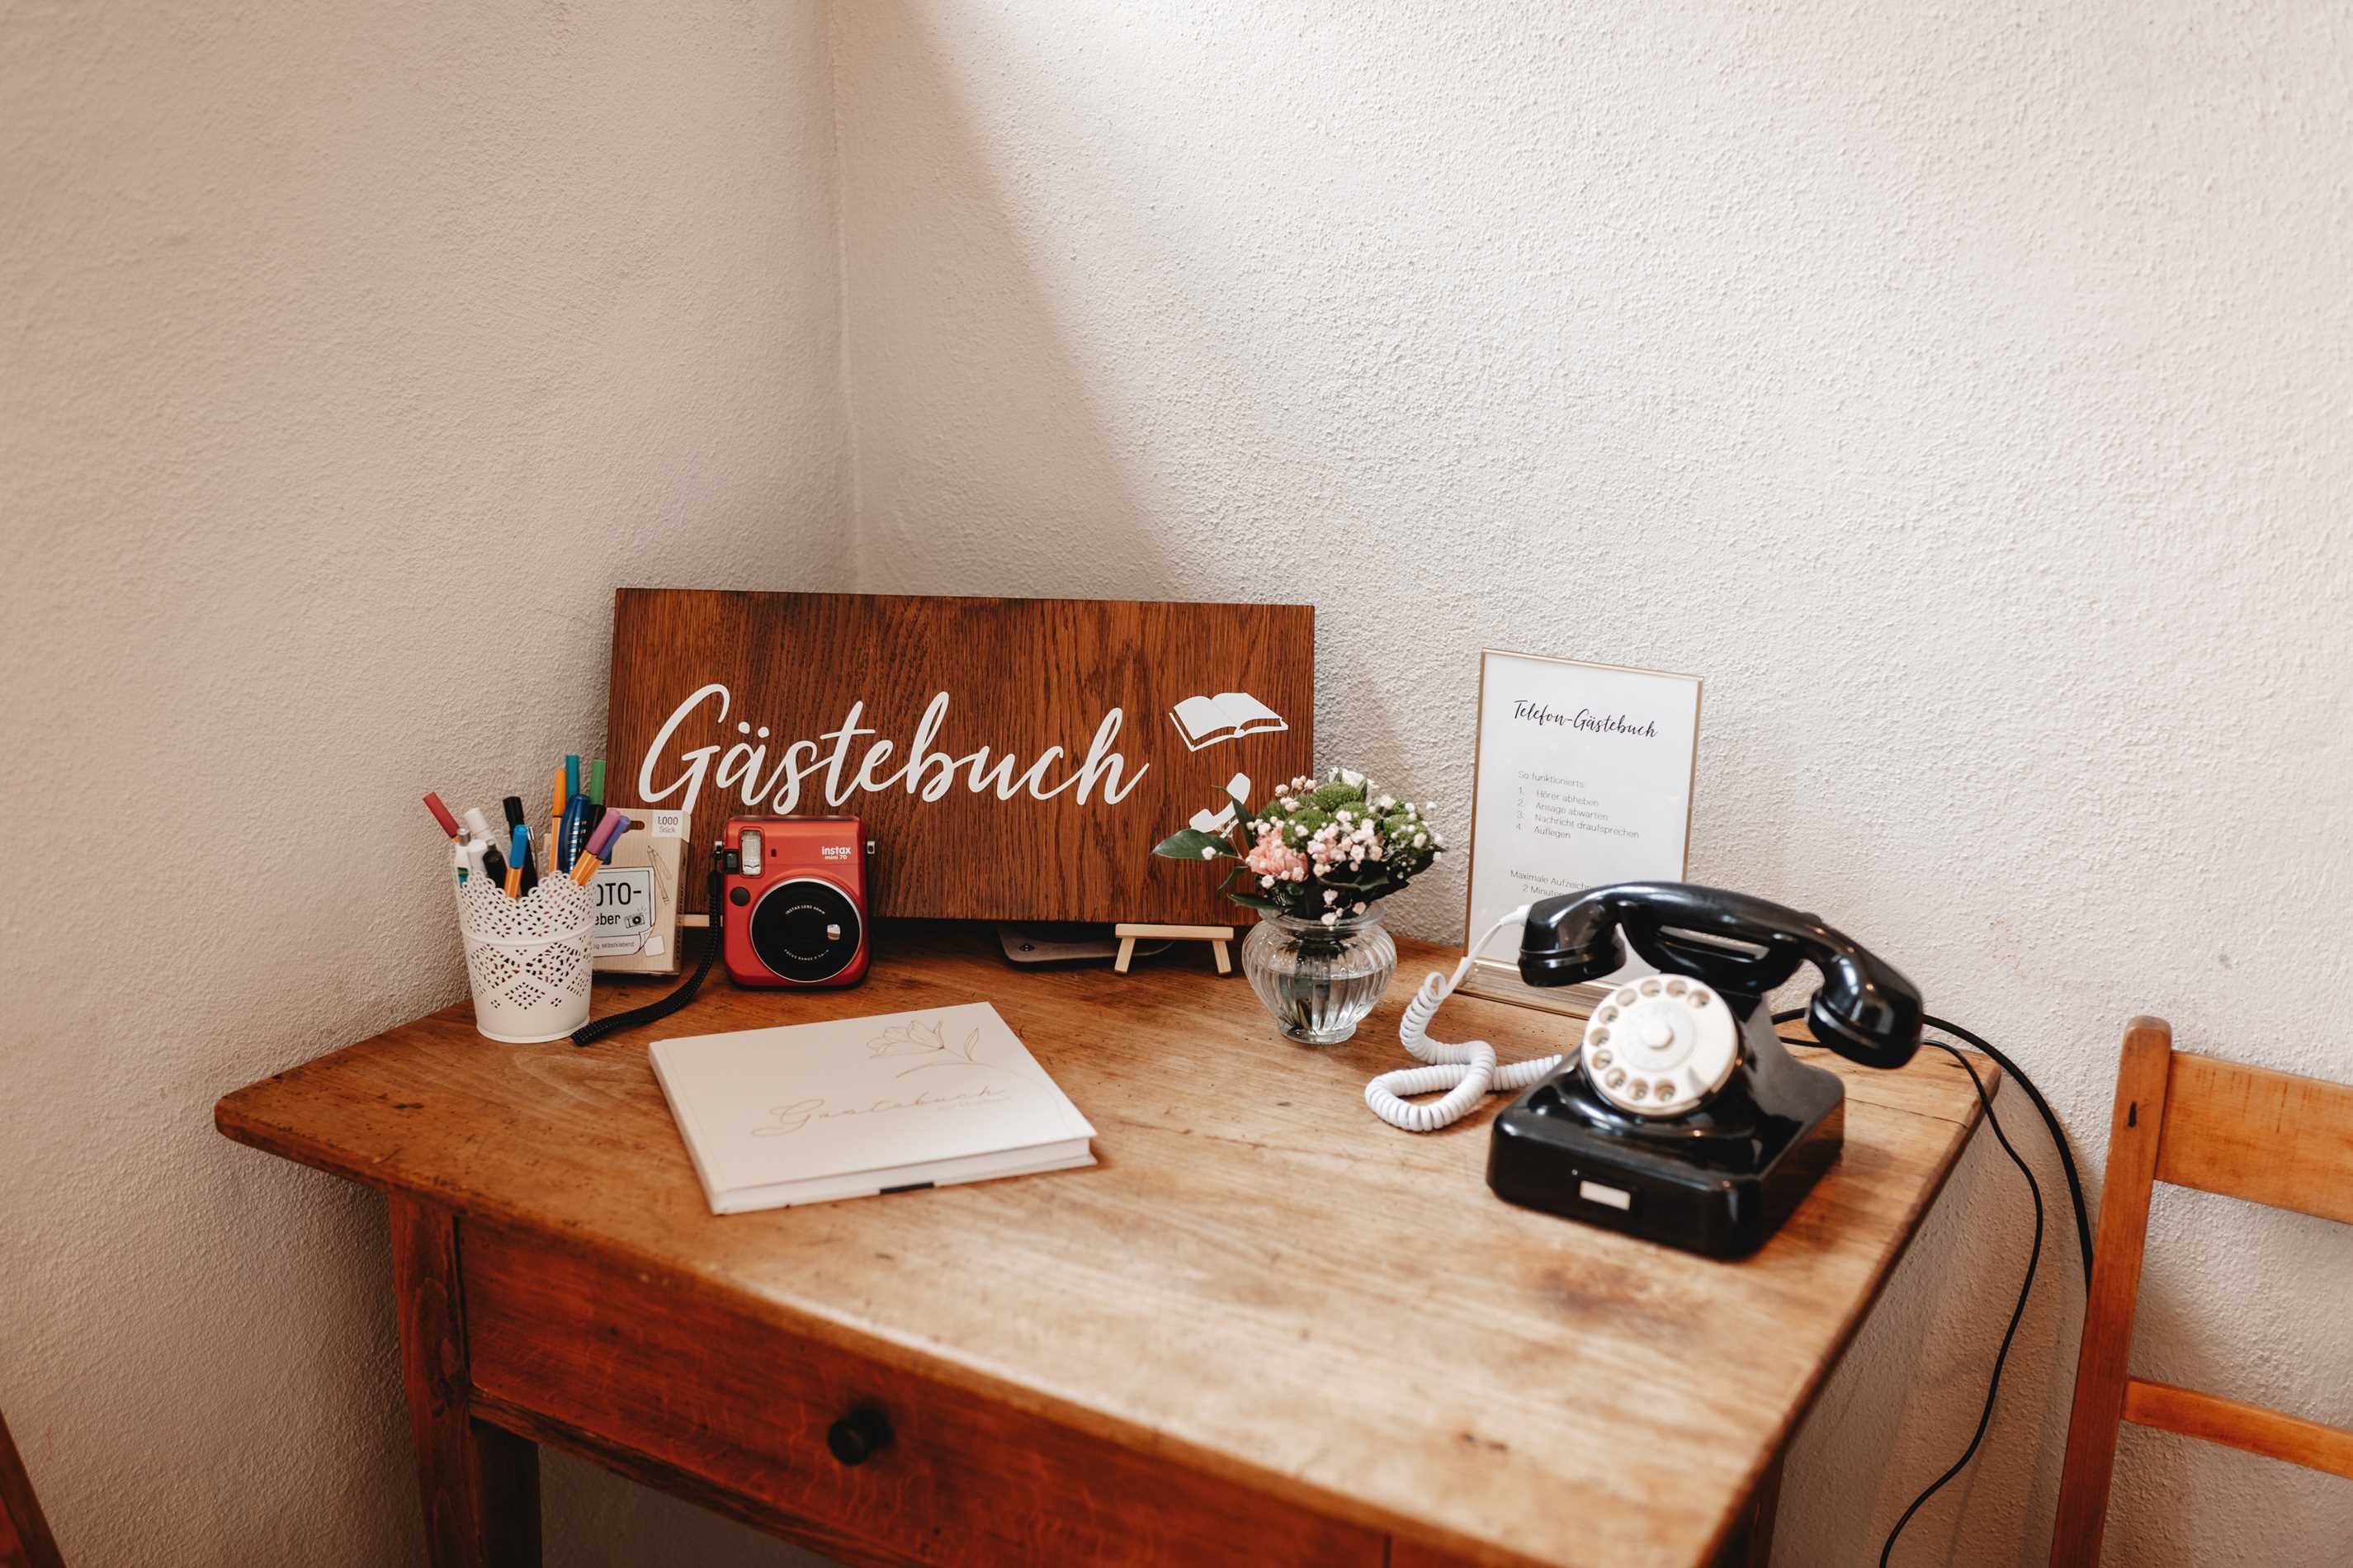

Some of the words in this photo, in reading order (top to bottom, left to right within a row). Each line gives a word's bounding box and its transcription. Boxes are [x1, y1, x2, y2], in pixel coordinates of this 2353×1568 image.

[1514, 700, 1658, 738] Telefon-Gästebuch
[638, 683, 1151, 815] Gästebuch
[1518, 771, 1530, 780] So
[1536, 789, 1561, 801] Hörer
[1562, 793, 1599, 807] abheben
[1535, 801, 1567, 815] Ansage
[1568, 807, 1609, 821] abwarten
[657, 815, 678, 826] 1.000
[1534, 814, 1576, 828] Nachricht
[1576, 821, 1640, 840] draufsprechen
[1533, 826, 1571, 840] Auflegen
[821, 845, 852, 856] instax
[1510, 869, 1549, 885] Maximale
[595, 882, 642, 907] OTO-
[1523, 884, 1528, 892] 2
[594, 913, 621, 925] eber
